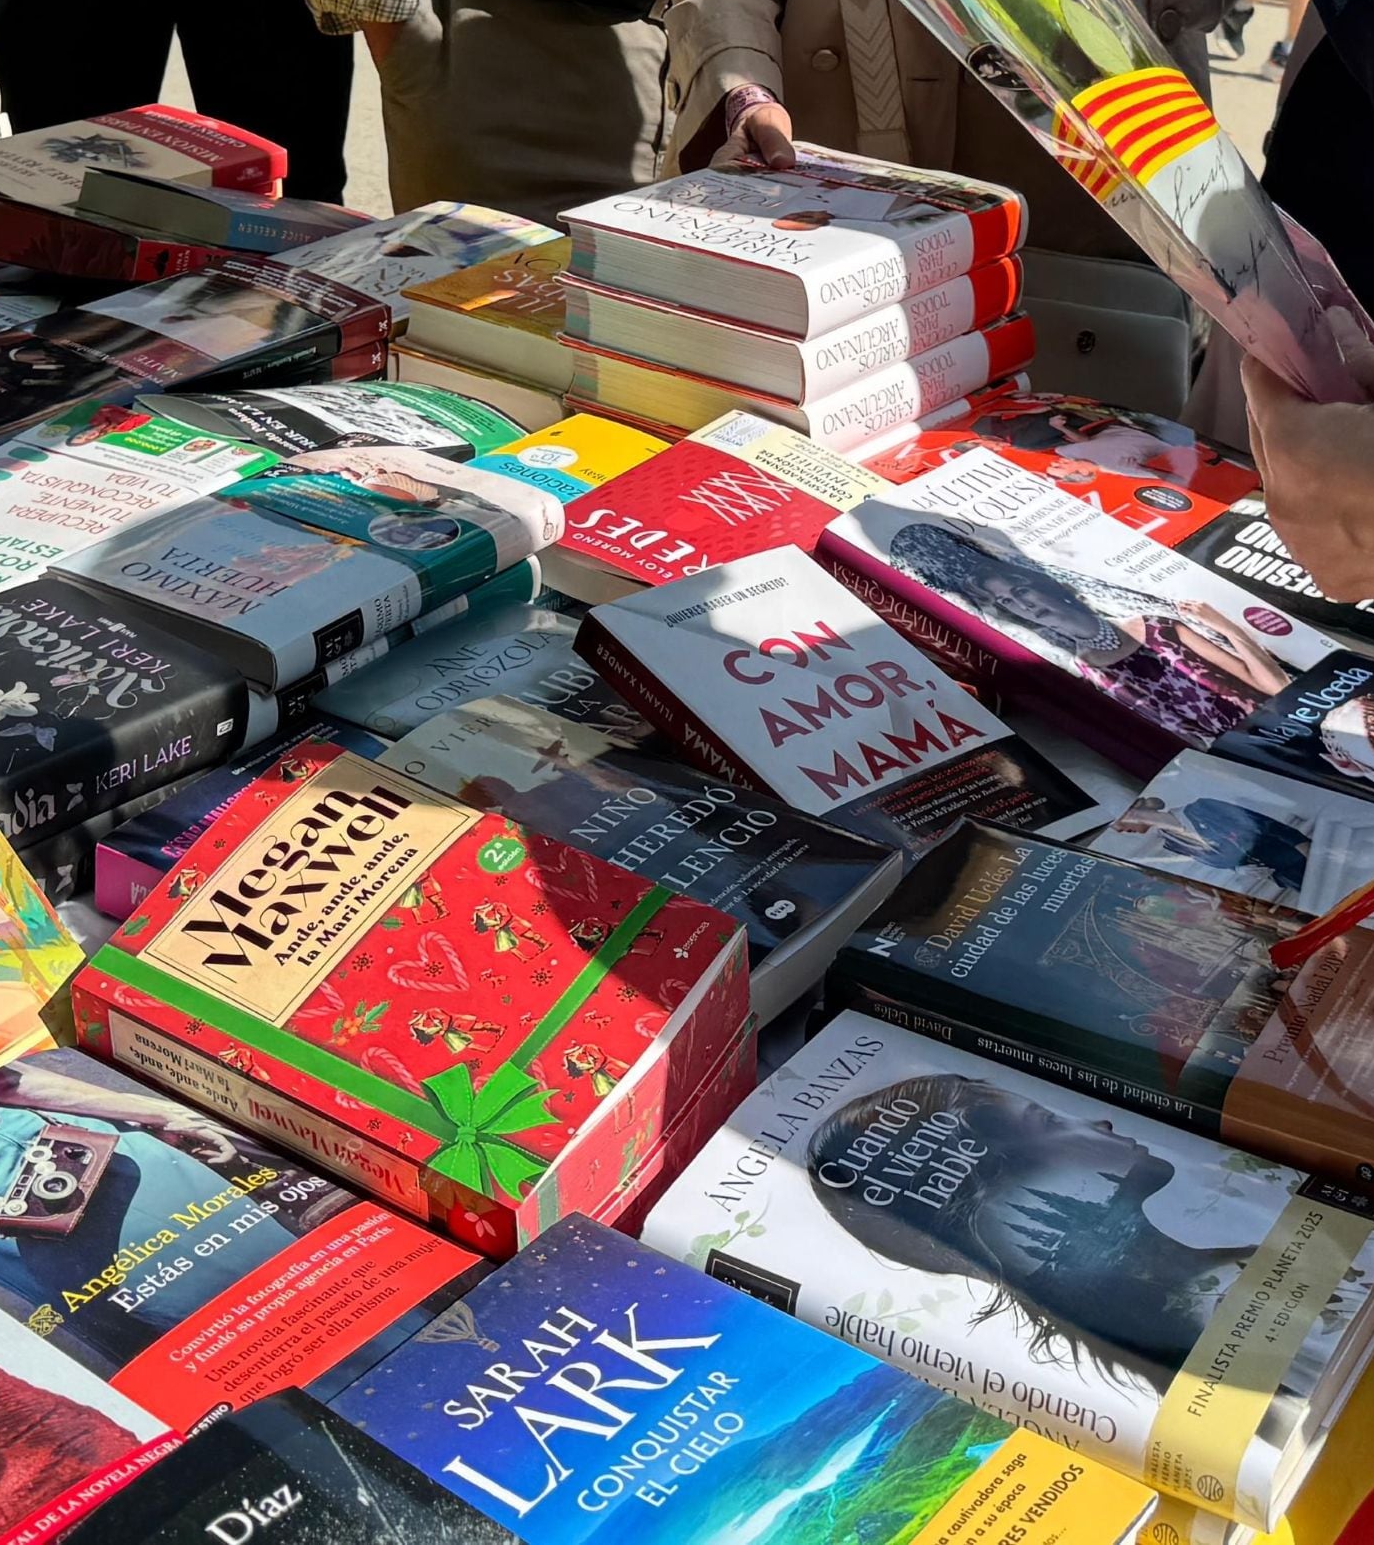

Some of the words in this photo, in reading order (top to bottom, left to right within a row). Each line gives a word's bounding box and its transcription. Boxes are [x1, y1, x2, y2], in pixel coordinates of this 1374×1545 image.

[237, 222, 277, 239] KELLEN
[914, 229, 955, 251] TODOS
[819, 254, 905, 305] ARGUIÑANO
[19, 470, 160, 511] RECONQUISTA
[105, 472, 149, 490] VIDA
[6, 504, 112, 536] RECUPERA
[569, 508, 725, 578] REDES
[572, 533, 635, 564] MORENO
[1103, 538, 1154, 568] Cayetano
[121, 561, 264, 617] MÁXIMO
[160, 546, 289, 598] HUERTA
[635, 558, 674, 581] ELOY
[661, 603, 707, 630] ¿QUIERES
[414, 631, 564, 711] ODRIOZOLA
[427, 643, 488, 678] ANE
[595, 642, 638, 687] XANDER
[722, 619, 855, 686] CON
[758, 660, 938, 749] AMOR,
[1304, 666, 1374, 710] Uceda
[94, 758, 138, 795] KERI
[142, 734, 193, 774] LAKE
[796, 698, 989, 802] MAMÁ
[571, 784, 659, 845] NIÑO
[616, 783, 737, 873] HEREDÓ
[180, 788, 363, 951] Megan
[201, 785, 413, 984] Maxwell
[319, 908, 360, 954] Mari
[359, 846, 419, 910] Morena
[1001, 881, 1039, 907] las
[1028, 846, 1069, 884] luces
[1040, 856, 1099, 915] muertas
[274, 916, 326, 967] Ande,
[324, 871, 369, 923] ande,
[925, 897, 980, 953] David
[964, 865, 1016, 906] Uclés
[1261, 1009, 1308, 1066] Premio
[1302, 968, 1336, 1016] Nadal
[703, 1111, 810, 1213] ÁNGELA
[792, 1034, 886, 1112] BANZAS
[1122, 1083, 1172, 1111] ciudad
[817, 1097, 921, 1190] Cuando
[881, 1110, 961, 1179] viento
[903, 1136, 989, 1211] hable
[862, 1174, 903, 1208] el
[60, 1224, 180, 1314] Angélica
[169, 1164, 282, 1238] Morales
[107, 1253, 194, 1315] Estás
[191, 1228, 233, 1262] en
[230, 1198, 284, 1238] mis
[280, 1173, 329, 1216] ojos
[295, 1252, 344, 1293] agencia
[358, 1224, 396, 1248] París.
[168, 1311, 235, 1364] Convirtió
[245, 1257, 311, 1310] fotografía
[351, 1210, 393, 1241] pasión
[223, 1334, 301, 1394] desentierra
[378, 1257, 408, 1281] una
[406, 1237, 444, 1265] mujer
[238, 1326, 285, 1364] novela
[280, 1276, 351, 1328] fascinante
[353, 1285, 401, 1320] misma.
[1186, 1340, 1241, 1417] FINALISTA
[1229, 1289, 1271, 1340] PREMIO
[1261, 1238, 1307, 1290] PLANETA
[1296, 1210, 1324, 1239] 2025
[1275, 1282, 1311, 1328] EDICIÓN
[824, 1305, 896, 1358] hable
[900, 1335, 976, 1385] viento
[440, 1305, 598, 1431] SARAH
[441, 1302, 722, 1519] LARK
[577, 1370, 740, 1513] CONQUISTAR
[1011, 1379, 1119, 1445] Cuando
[80, 1462, 138, 1504] NOVELA
[135, 1437, 185, 1473] NEGRA
[670, 1410, 745, 1486] CIELO
[944, 1472, 1005, 1538] cautivadora
[1001, 1451, 1028, 1482] saga
[994, 1482, 1028, 1519] época
[1022, 1462, 1086, 1525] VENDIDOS
